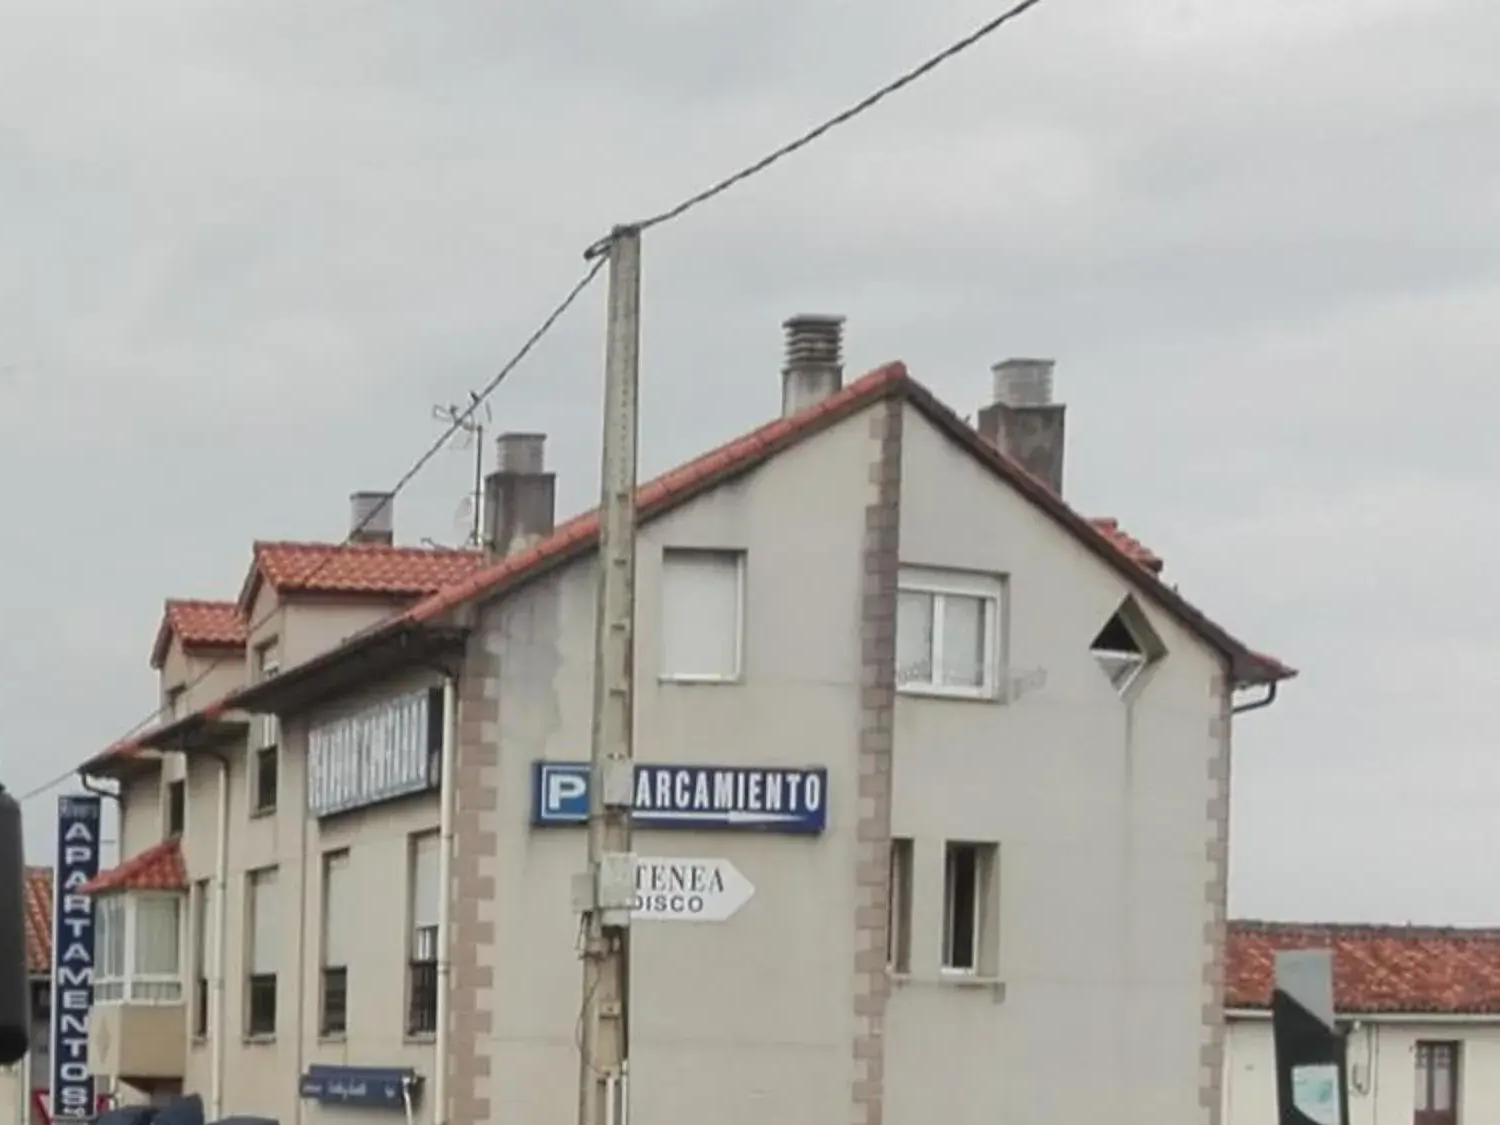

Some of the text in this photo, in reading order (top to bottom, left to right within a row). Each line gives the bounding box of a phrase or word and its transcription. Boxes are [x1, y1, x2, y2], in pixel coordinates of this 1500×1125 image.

[548, 769, 821, 812] P ARCAMIENTO
[635, 864, 724, 895] TENEA
